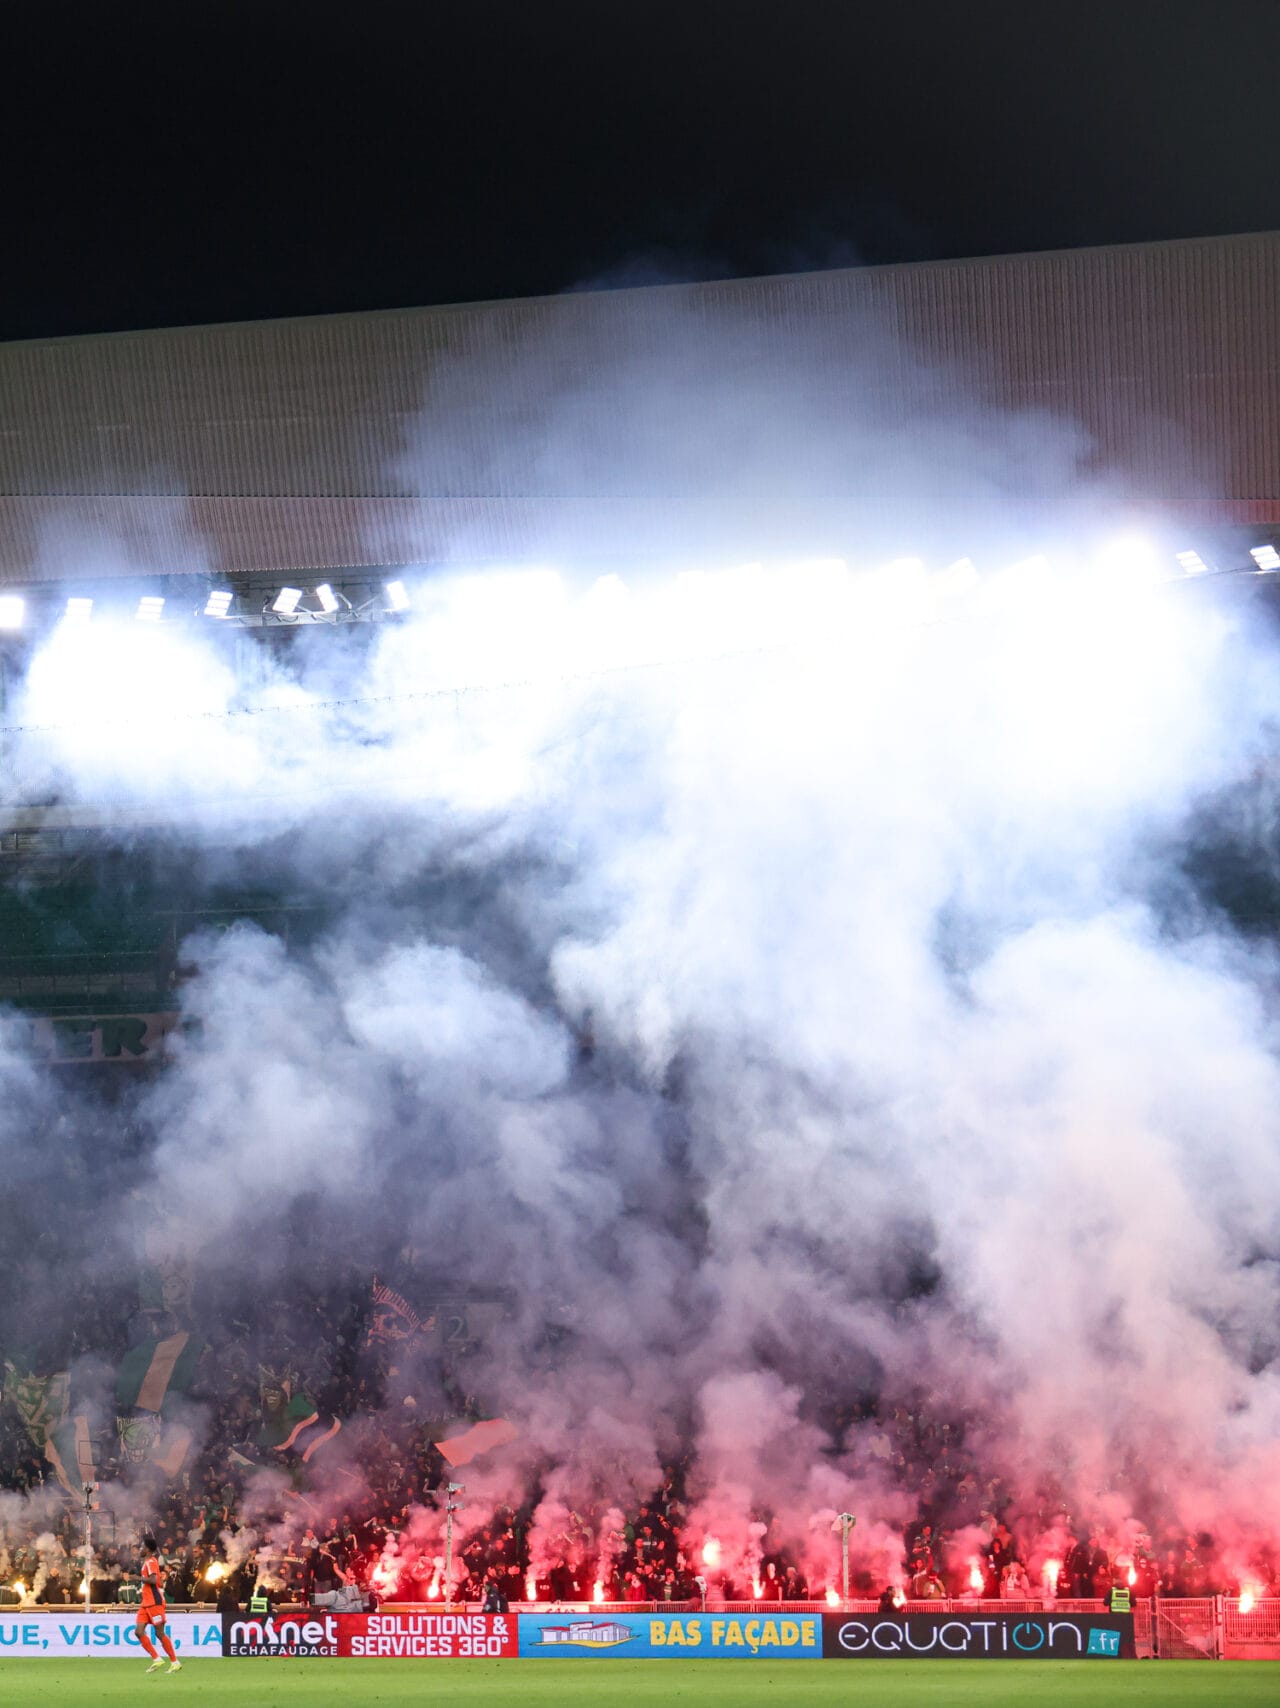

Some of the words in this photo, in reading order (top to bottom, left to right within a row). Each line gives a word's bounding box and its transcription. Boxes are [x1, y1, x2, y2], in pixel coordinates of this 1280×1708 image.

[193, 1625, 222, 1646] IA
[367, 1616, 486, 1635] SOLUTIONS
[493, 1616, 509, 1635] &
[351, 1636, 455, 1656] SERVICES
[458, 1636, 509, 1656] 360°
[649, 1620, 702, 1646] BAS
[711, 1620, 816, 1654] FAÇADE
[230, 1645, 338, 1656] ECHAFAUDAGE
